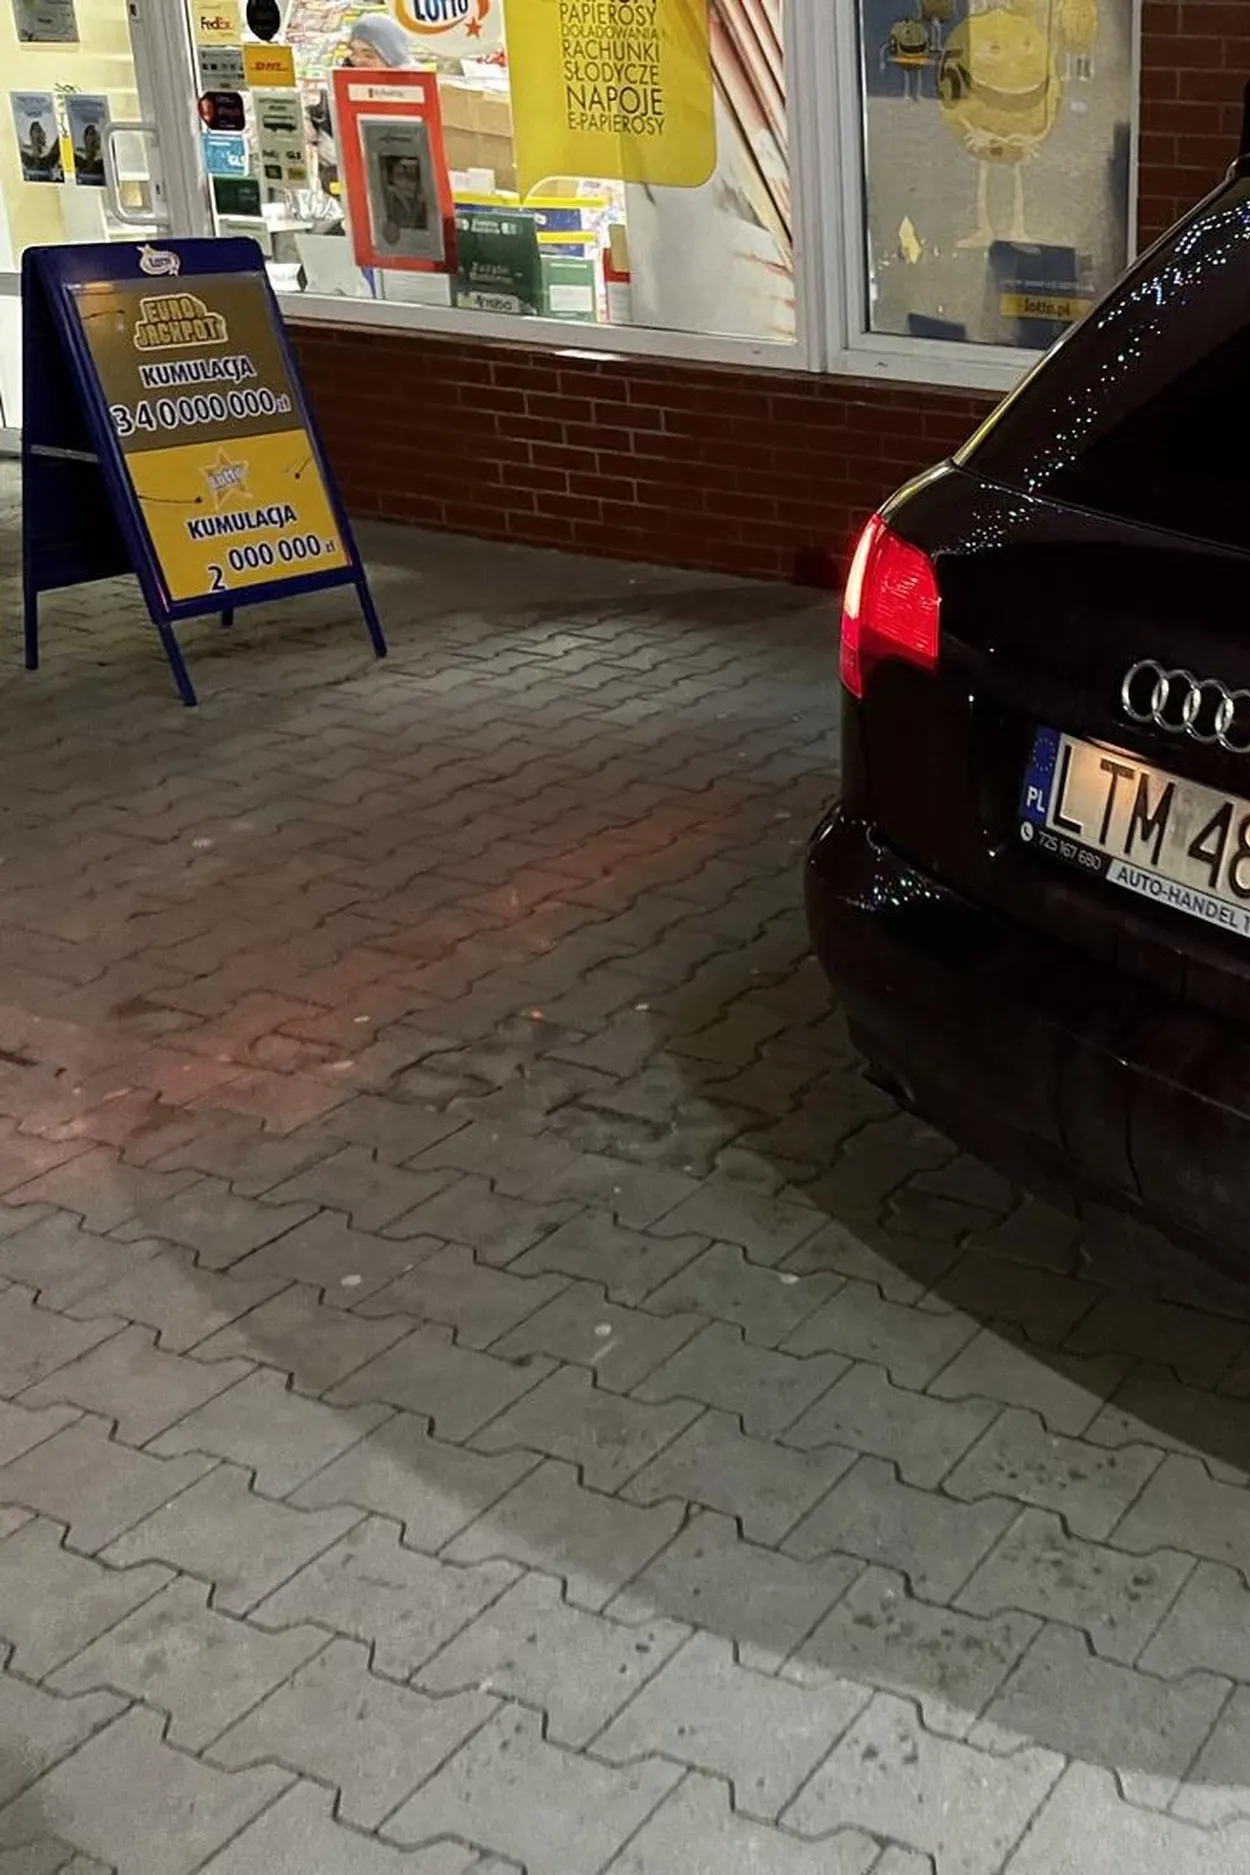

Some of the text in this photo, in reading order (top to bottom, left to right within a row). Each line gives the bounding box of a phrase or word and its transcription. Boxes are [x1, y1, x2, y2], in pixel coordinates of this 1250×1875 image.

[559, 3, 657, 27] PAPIEROSY
[562, 39, 660, 63] RACHUNKI
[563, 60, 660, 85] SŁODYCZE
[566, 85, 663, 116] NAPOJE
[568, 112, 666, 136] E-PAPIEROSY
[138, 318, 217, 347] JACKPOT
[140, 357, 256, 387] KUMULACJA
[186, 504, 298, 540] KUMULACJA
[207, 565, 227, 591] 2
[1026, 785, 1046, 814] PL
[1053, 745, 1176, 865] LTM
[1117, 867, 1238, 928] AUTO-HANDEL
